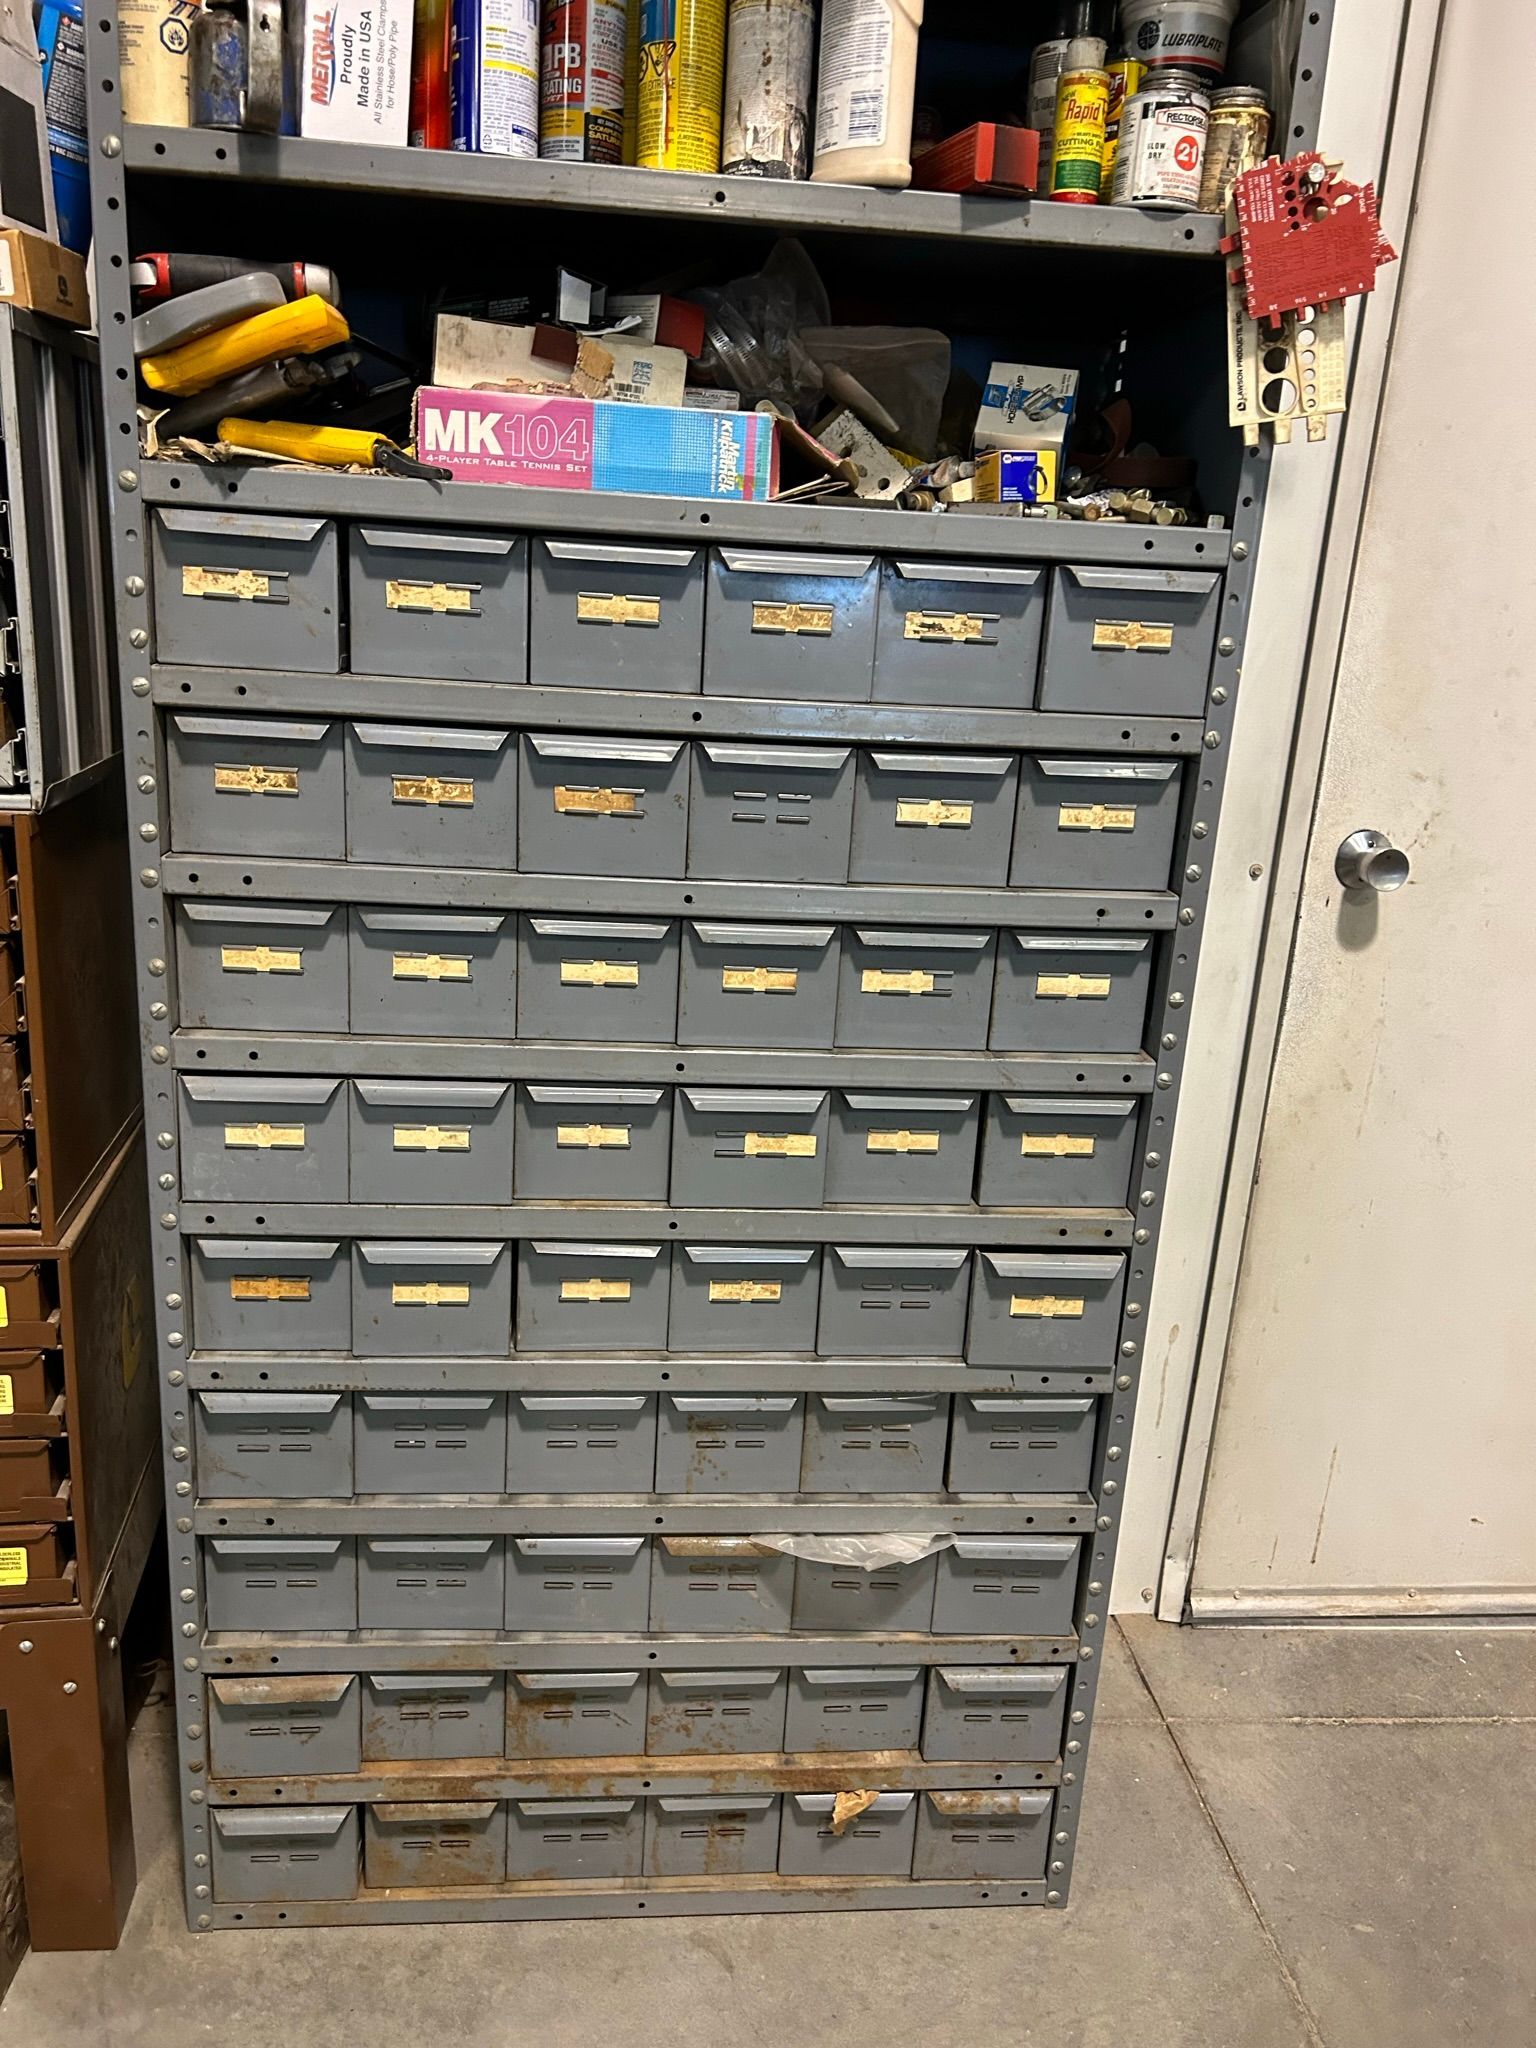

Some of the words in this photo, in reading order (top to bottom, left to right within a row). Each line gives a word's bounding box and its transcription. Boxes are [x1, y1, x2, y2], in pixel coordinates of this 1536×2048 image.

[360, 10, 372, 43] USA
[377, 0, 389, 36] Clamps
[389, 21, 399, 42] Pipe
[340, 24, 356, 85] Proudly
[358, 48, 370, 62] in
[376, 39, 386, 63] Steel
[554, 42, 581, 69] PB
[1161, 33, 1224, 52] LUBRIPLATE
[310, 10, 335, 106] MERRILL
[386, 45, 398, 94] Hose/Poly
[357, 66, 370, 107] Made
[374, 67, 384, 110] Stainless
[373, 111, 383, 124] All
[386, 98, 395, 109] for
[1065, 98, 1101, 123] Rapid
[1057, 138, 1094, 148] CUTTING
[1177, 142, 1198, 163] 21
[424, 408, 590, 461] MK104
[717, 419, 734, 494] Kilpatrick
[726, 441, 740, 491] Martin
